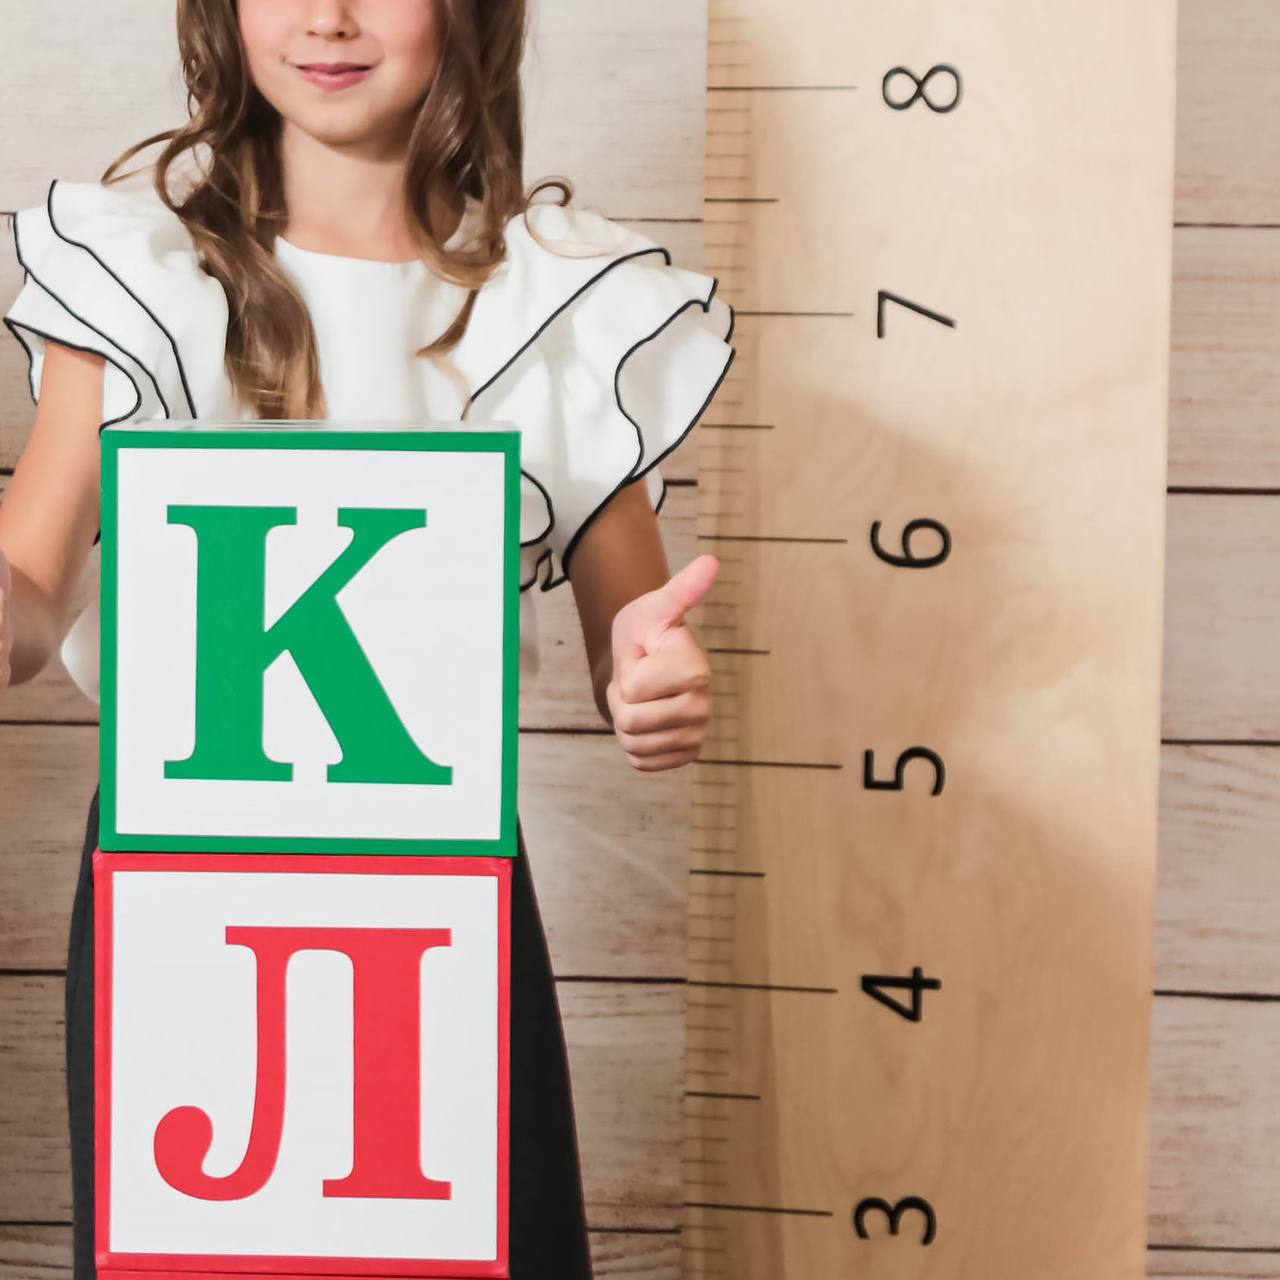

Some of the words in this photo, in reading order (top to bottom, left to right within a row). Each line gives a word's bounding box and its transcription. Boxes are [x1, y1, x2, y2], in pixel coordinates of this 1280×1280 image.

[881, 64, 961, 114] 8
[876, 290, 955, 339] 7
[870, 518, 952, 569] 6
[863, 746, 945, 797] 5
[860, 966, 942, 1023] 4
[853, 1196, 937, 1247] 3
